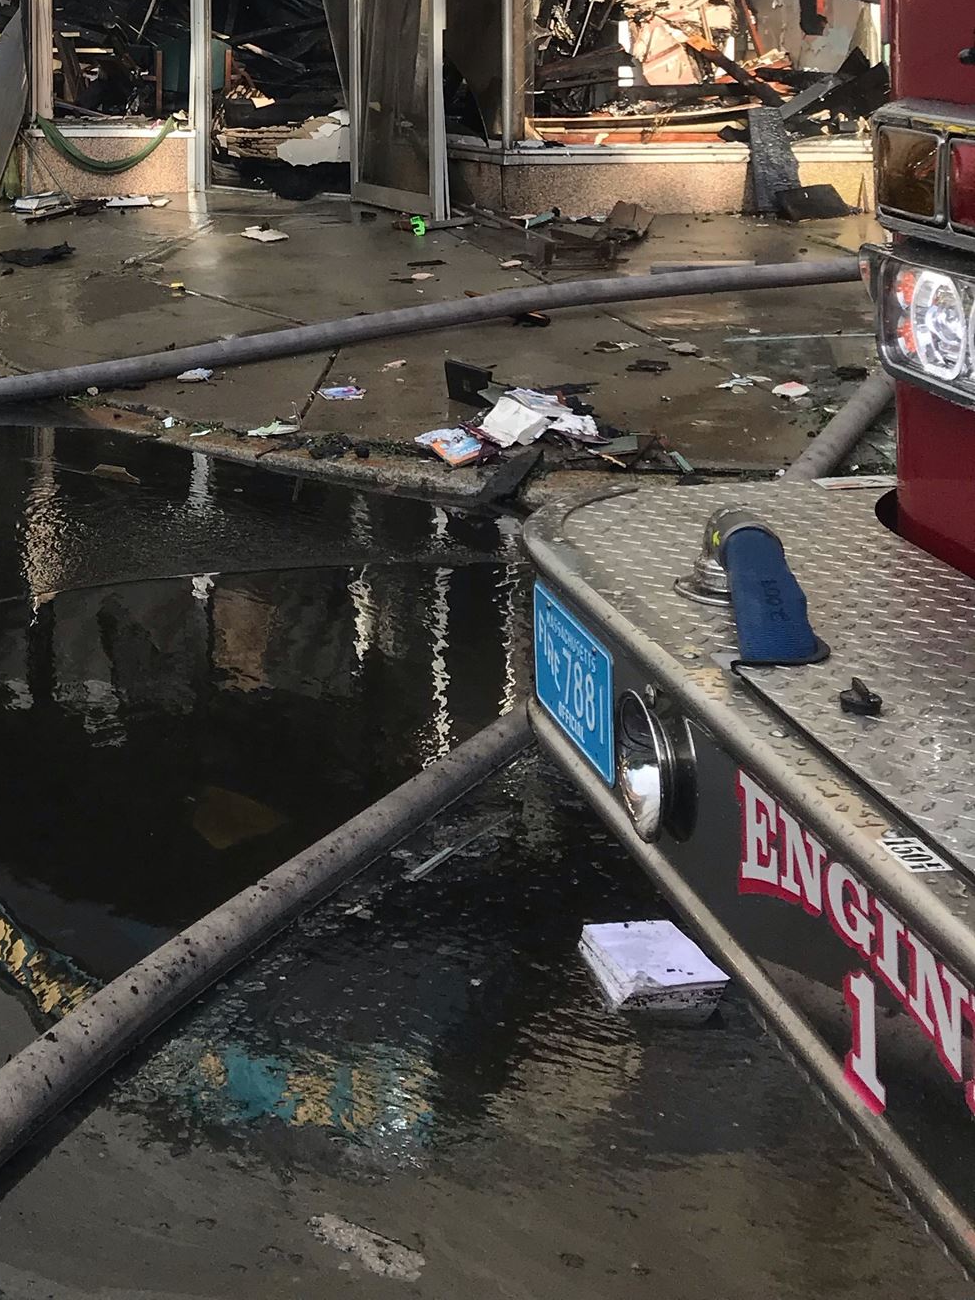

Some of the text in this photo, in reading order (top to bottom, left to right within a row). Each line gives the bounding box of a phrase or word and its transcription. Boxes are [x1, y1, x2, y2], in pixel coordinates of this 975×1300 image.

[538, 608, 561, 692] FIRE
[545, 609, 597, 674] MASSACHUSETTS
[558, 700, 586, 745] OFFICIAL
[562, 646, 605, 745] 7881
[737, 767, 975, 1116] ENGIN
[844, 969, 887, 1115] 1
